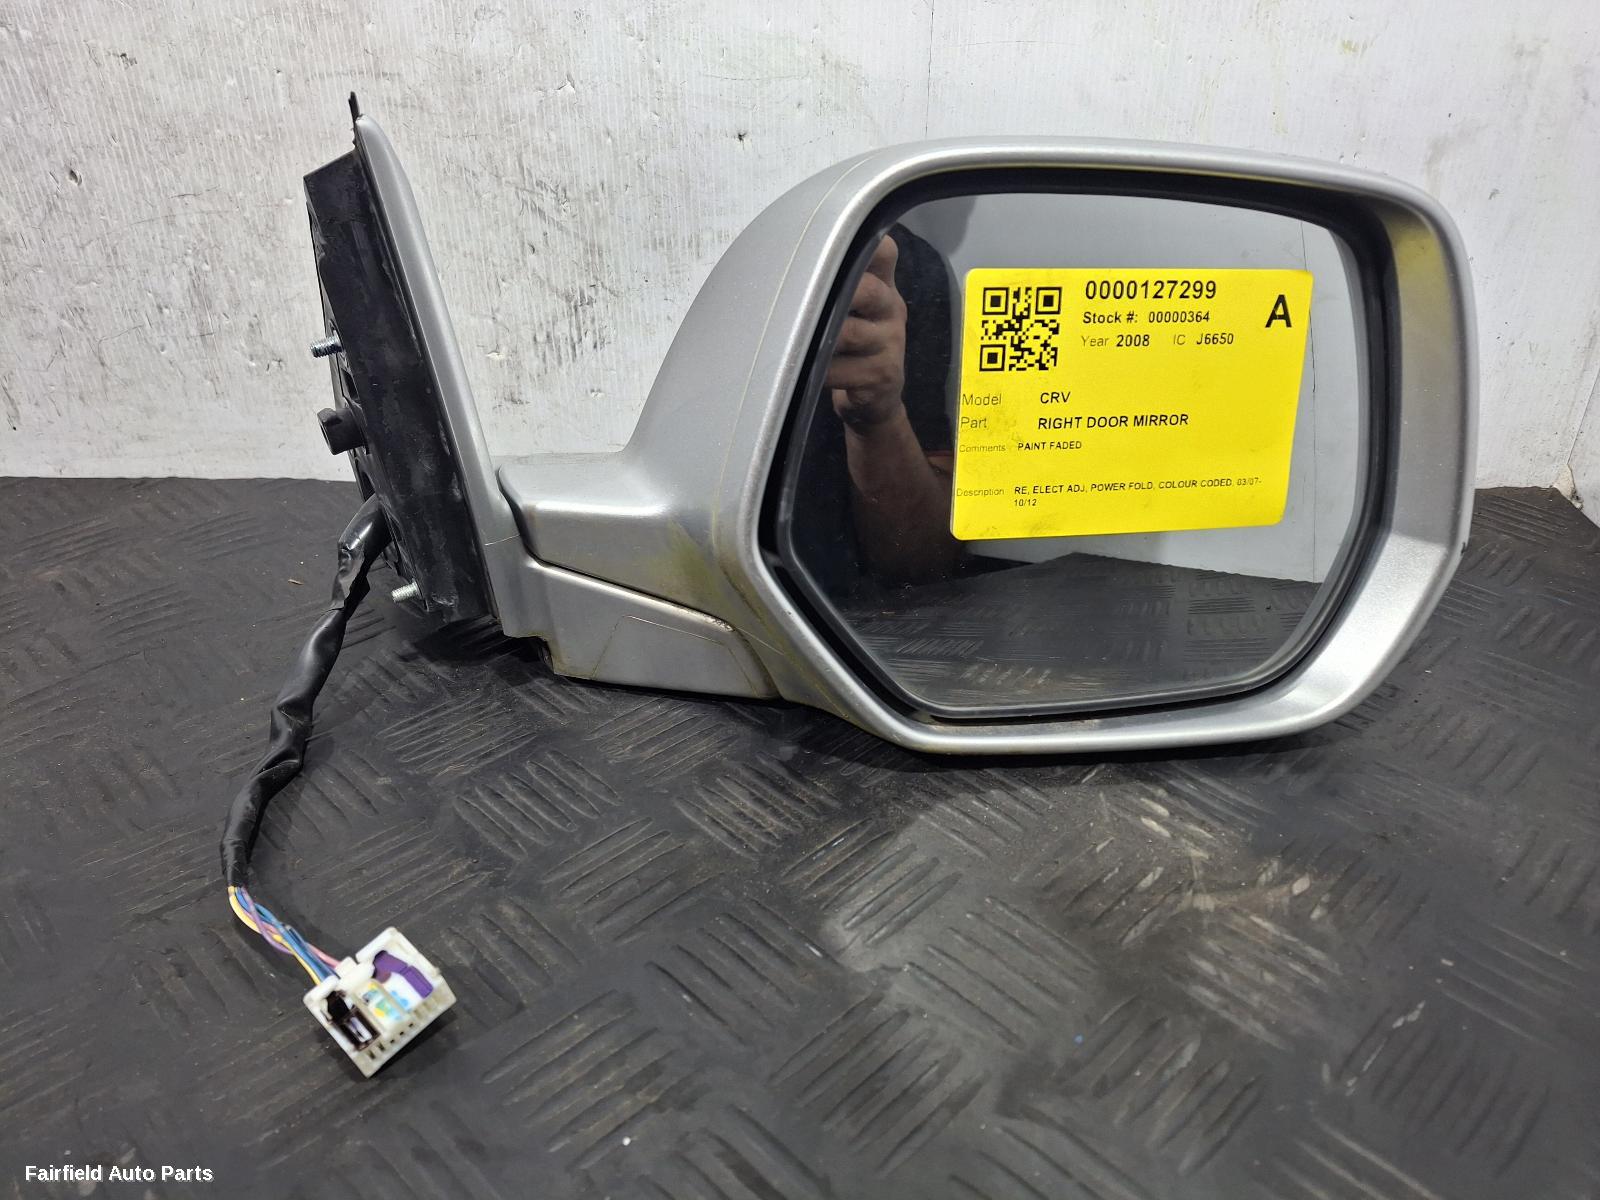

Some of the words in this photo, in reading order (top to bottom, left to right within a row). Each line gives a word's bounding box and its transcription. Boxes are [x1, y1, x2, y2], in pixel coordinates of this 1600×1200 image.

[1085, 280, 1217, 300] 0000127299
[1082, 311, 1121, 324] Stock
[1126, 311, 1138, 324] #:
[1148, 311, 1210, 323] 00000364
[1265, 294, 1292, 328] A
[1081, 335, 1109, 347] Year
[1116, 334, 1150, 347] 2008
[1173, 334, 1186, 346] IC
[1196, 333, 1234, 345] J6650
[962, 393, 1002, 406] Model
[1040, 391, 1071, 404] CRV
[960, 416, 987, 429] Part
[1037, 416, 1082, 430] RIGHT
[1086, 415, 1129, 428] DOOR
[1133, 414, 1189, 427] MIRROR
[959, 444, 1006, 453] Comments
[1017, 441, 1046, 451] PAINT
[1049, 440, 1082, 450] FADED
[956, 488, 1005, 498] Description
[1032, 485, 1064, 494] ELECT
[1090, 482, 1126, 492] POWER
[1158, 479, 1198, 489] COLOUR
[1014, 498, 1037, 507] 10/12
